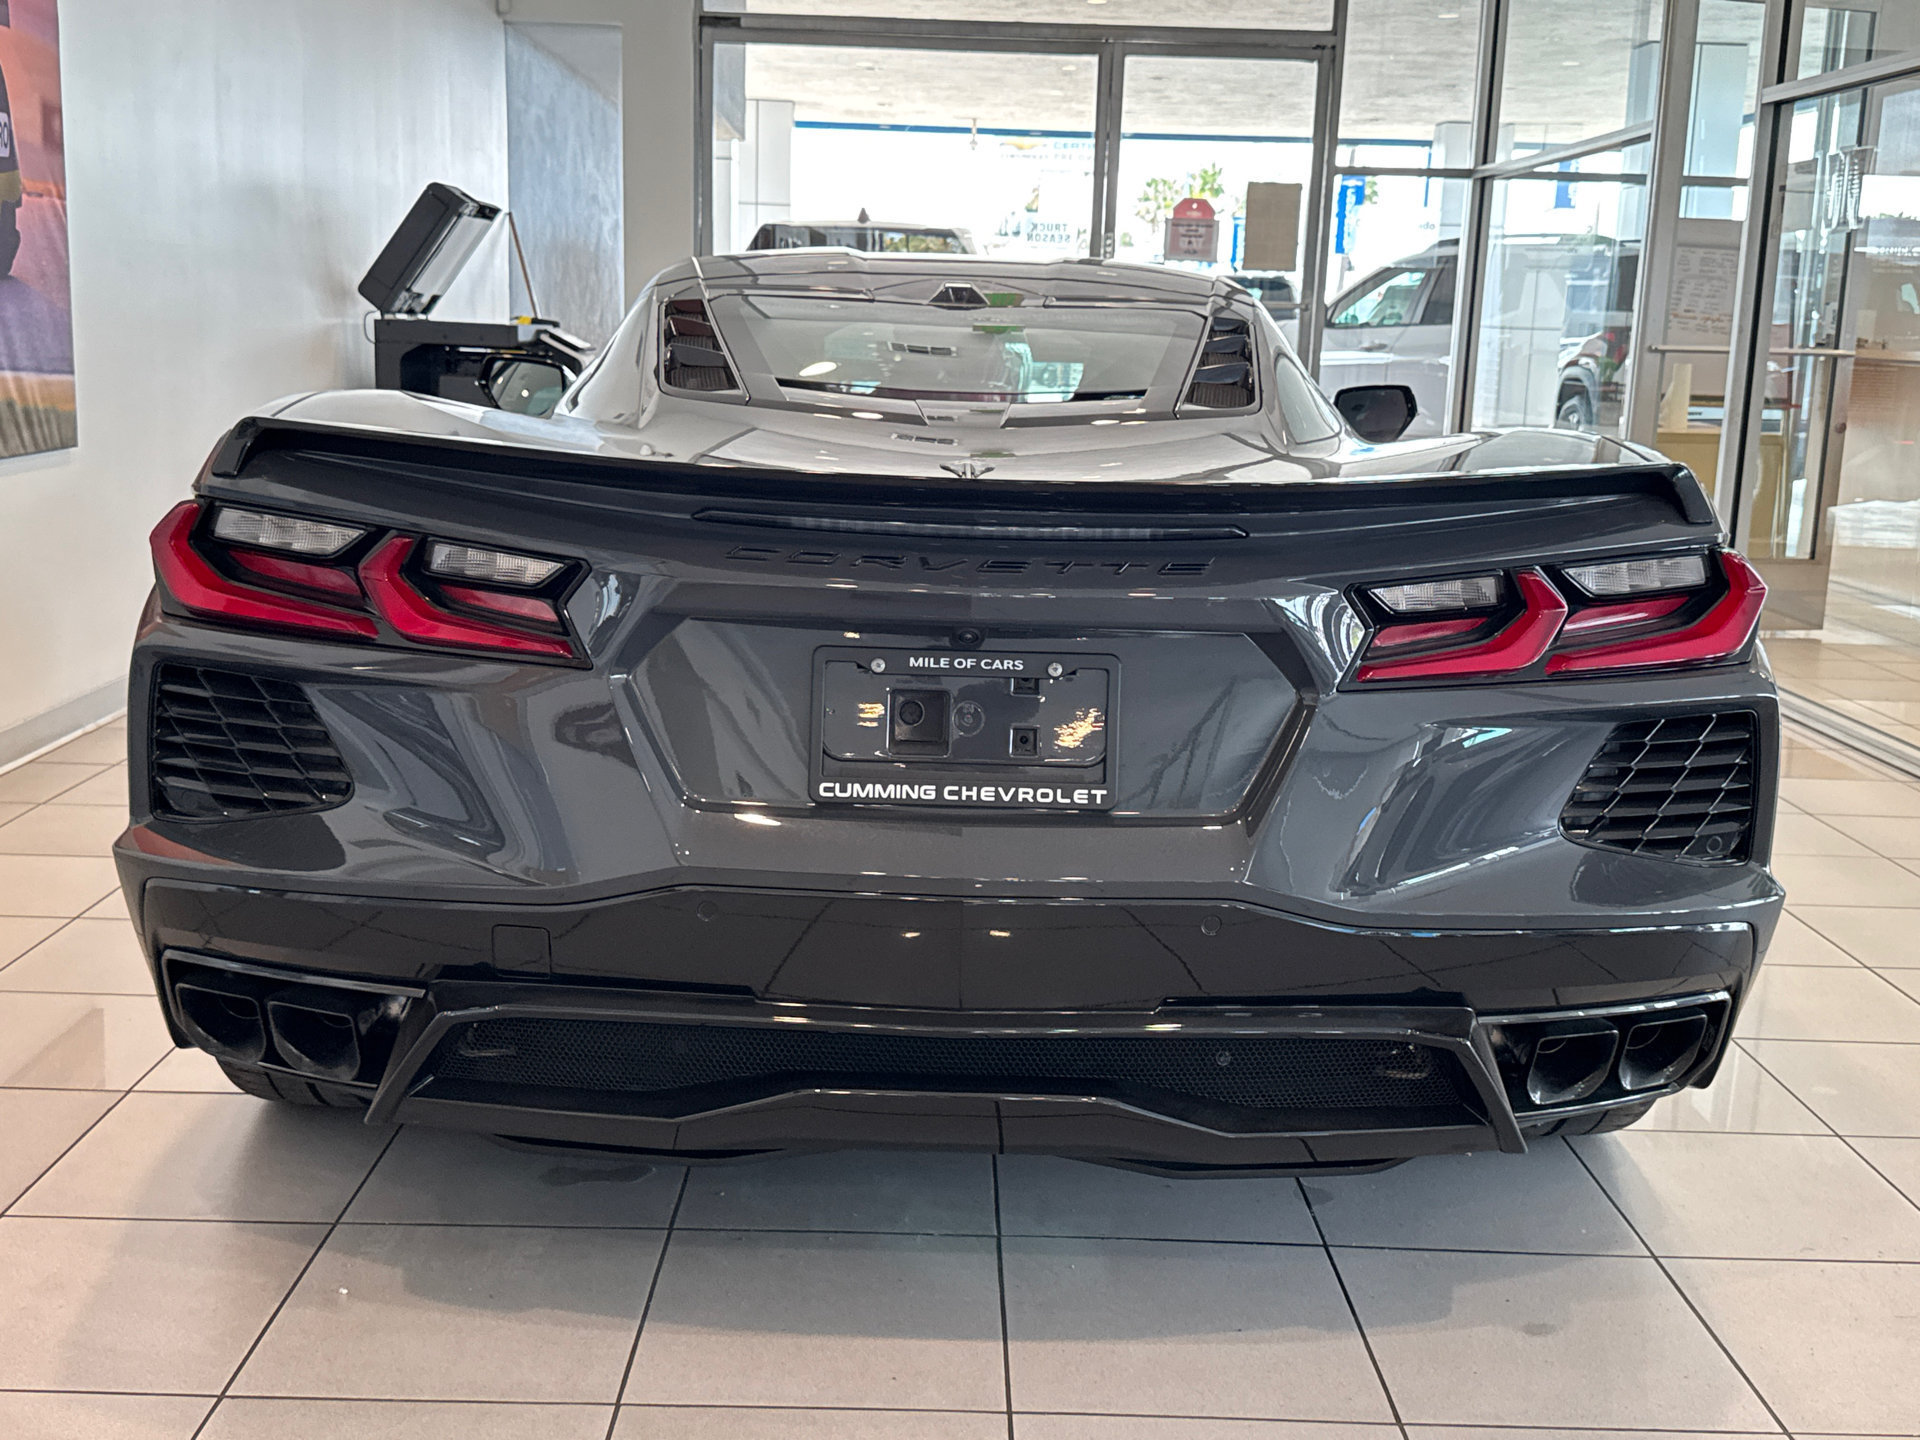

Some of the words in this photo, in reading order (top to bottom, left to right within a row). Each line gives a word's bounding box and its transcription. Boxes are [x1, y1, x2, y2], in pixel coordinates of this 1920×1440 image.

[725, 547, 1216, 576] CORVETTE
[909, 656, 950, 668] MILE
[954, 657, 976, 669] OF
[980, 659, 1024, 671] CARS
[818, 782, 937, 800] CUMMING
[943, 785, 1108, 805] CHEVROLET
